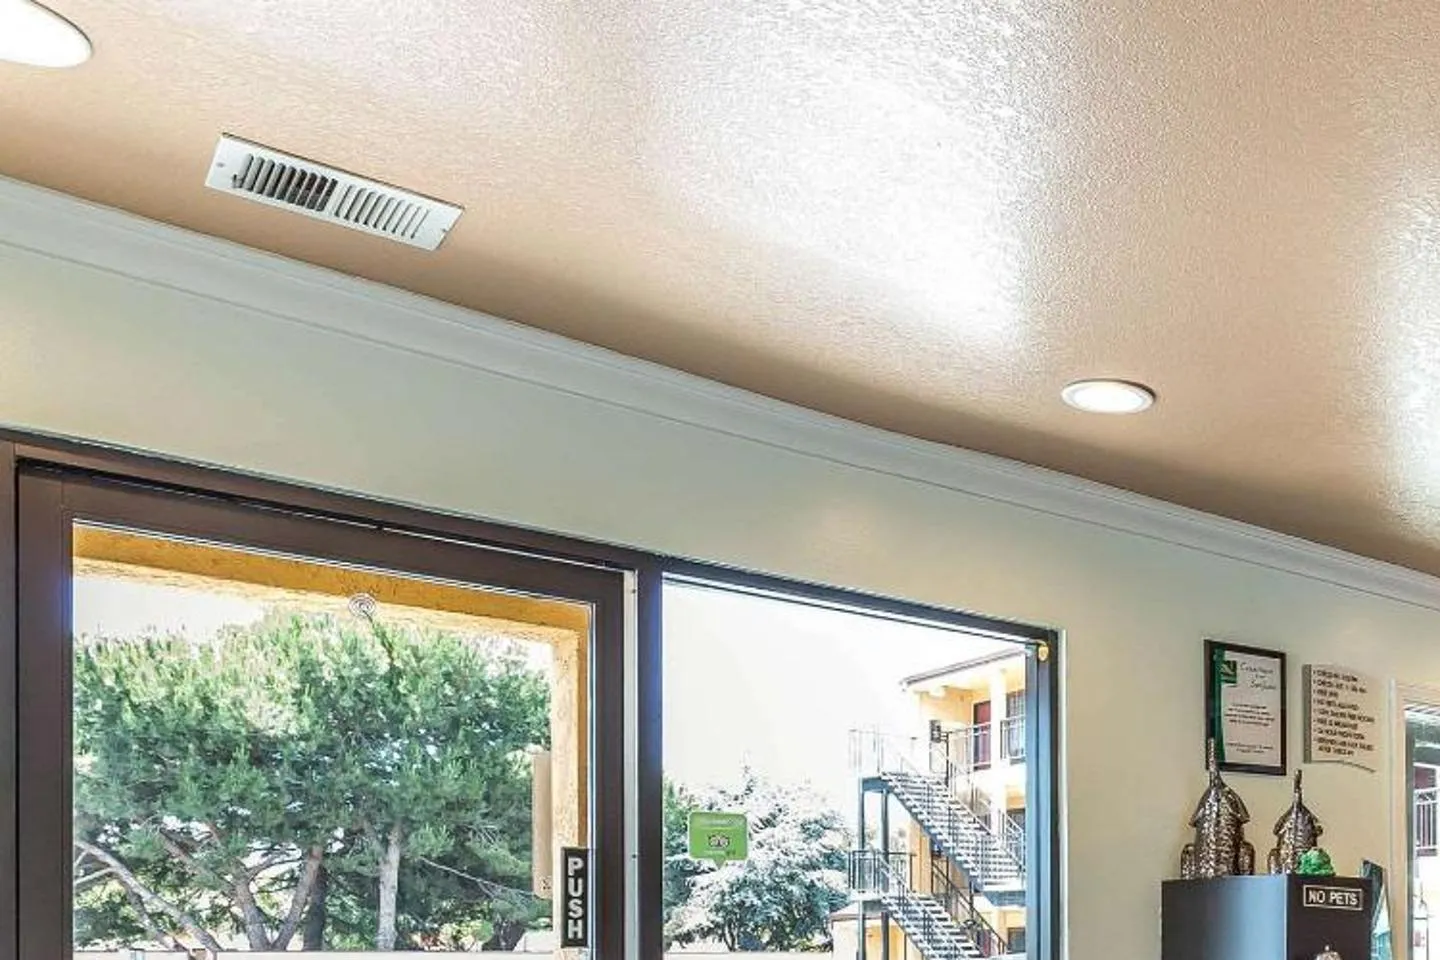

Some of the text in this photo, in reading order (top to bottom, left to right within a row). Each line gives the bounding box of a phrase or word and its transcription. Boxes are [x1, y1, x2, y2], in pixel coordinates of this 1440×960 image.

[567, 856, 585, 940] PUSH
[1308, 890, 1358, 906] NO PETS
